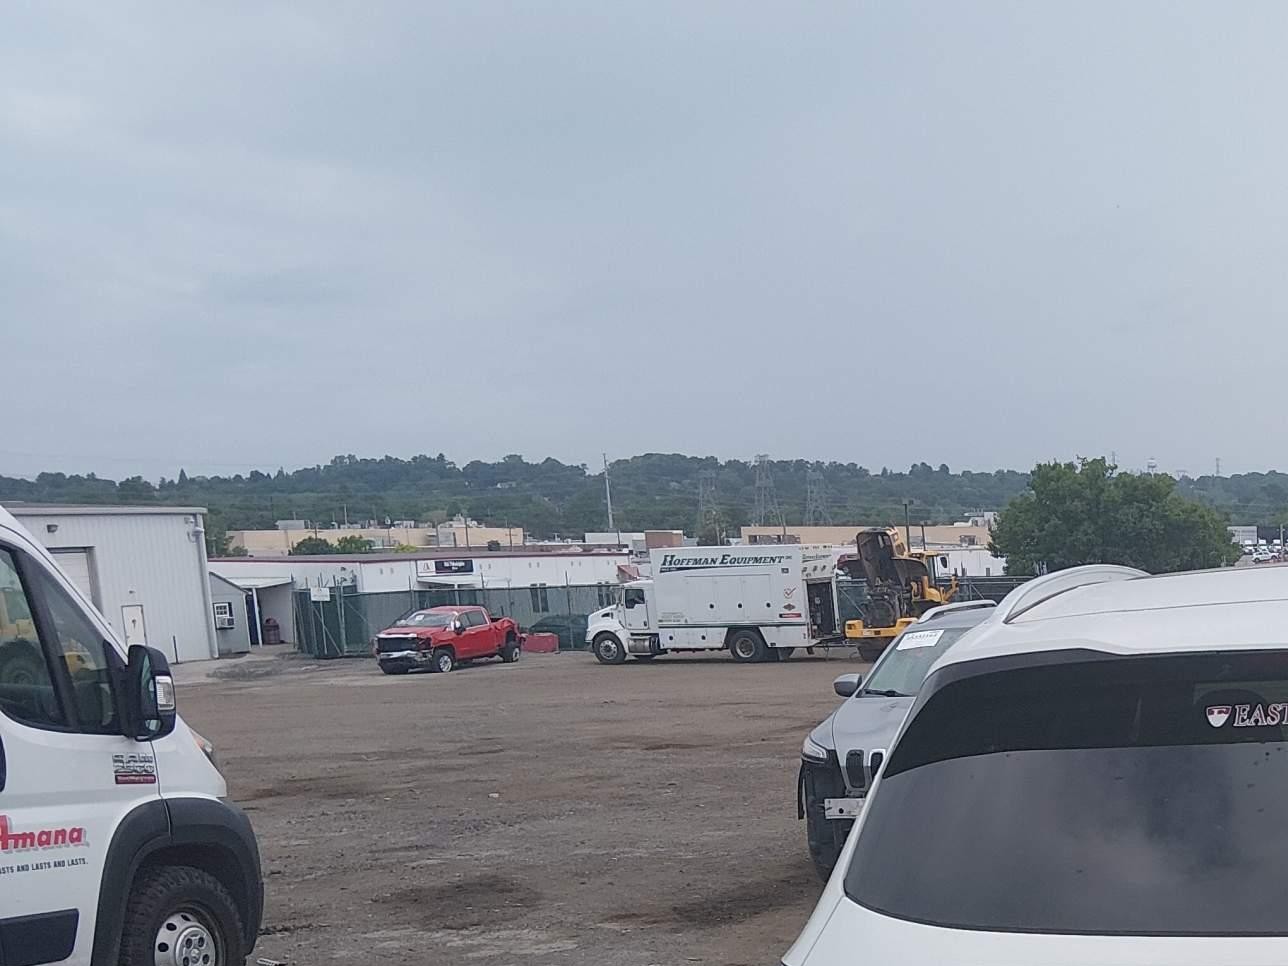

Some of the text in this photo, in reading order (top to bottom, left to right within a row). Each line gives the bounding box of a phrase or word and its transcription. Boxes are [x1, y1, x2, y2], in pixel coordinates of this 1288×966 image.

[661, 554, 718, 566] HOFFMAN
[719, 554, 784, 565] EQUIPMENT
[17, 864, 30, 873] AND
[32, 861, 51, 871] LASTS
[54, 860, 66, 868] AND
